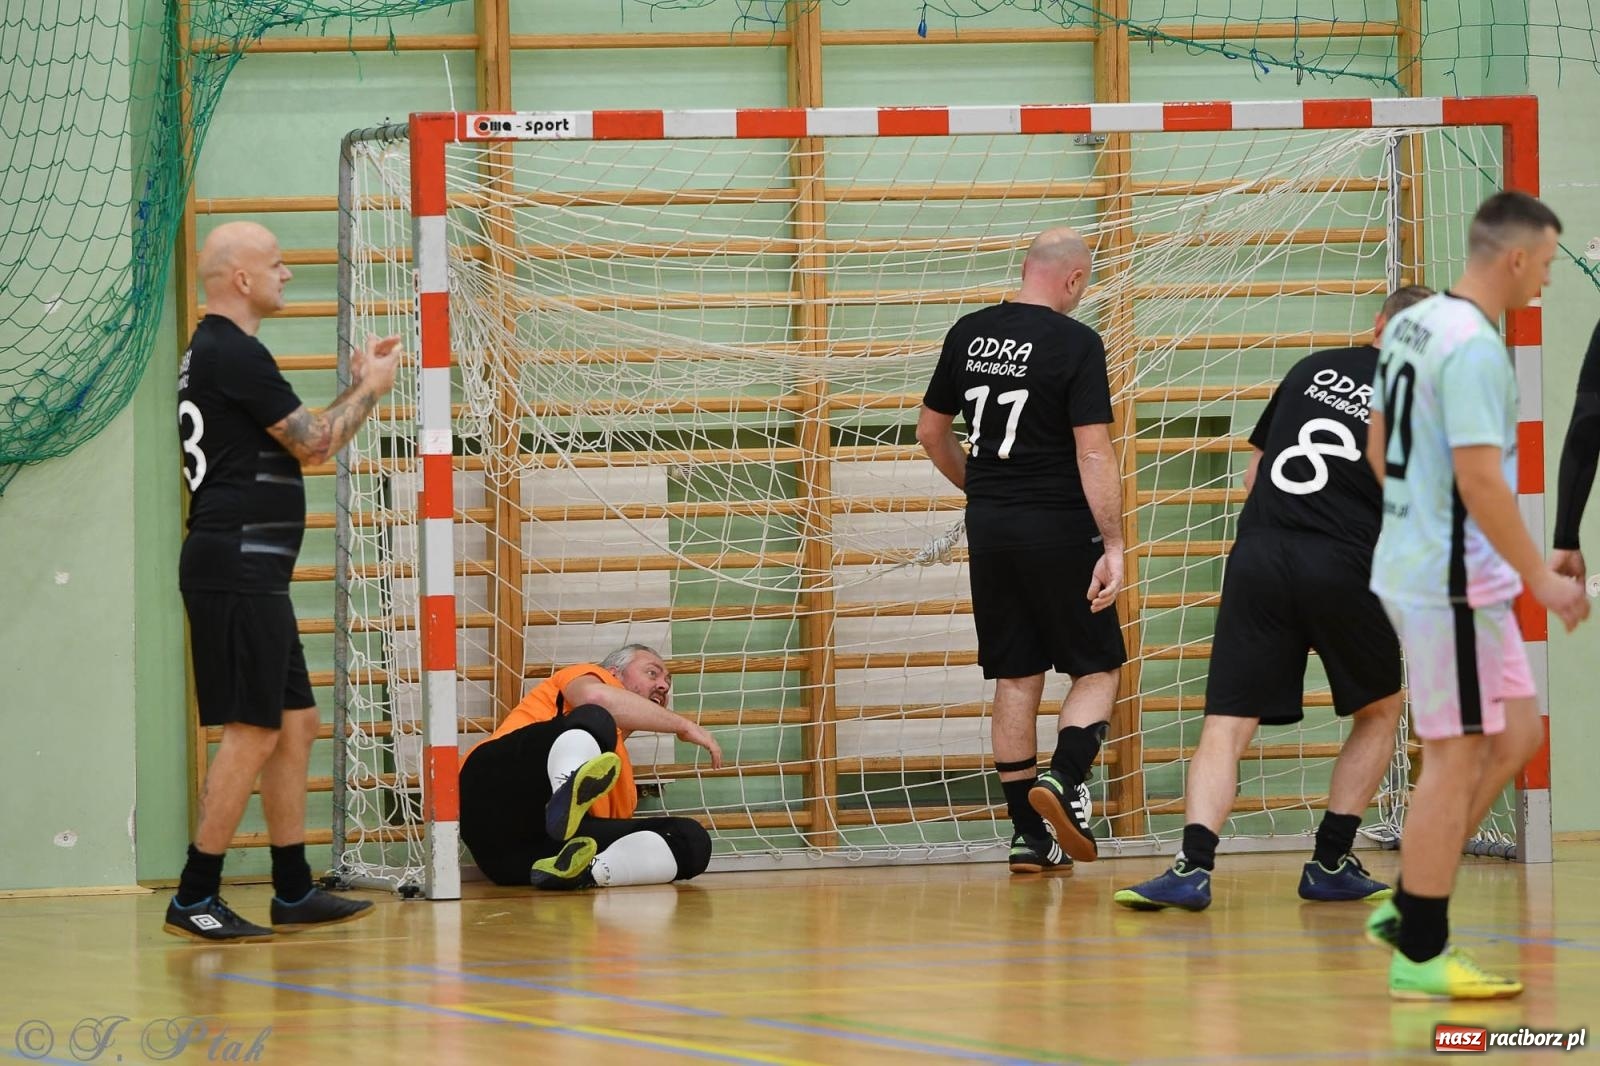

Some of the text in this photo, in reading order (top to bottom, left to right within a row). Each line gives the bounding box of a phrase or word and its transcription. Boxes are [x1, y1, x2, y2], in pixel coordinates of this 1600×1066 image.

[525, 118, 569, 134] sport
[967, 337, 1033, 362] ODRA
[965, 359, 1028, 377] RACIBÓRZ
[1313, 368, 1375, 407] ODR
[1270, 418, 1362, 495] 8
